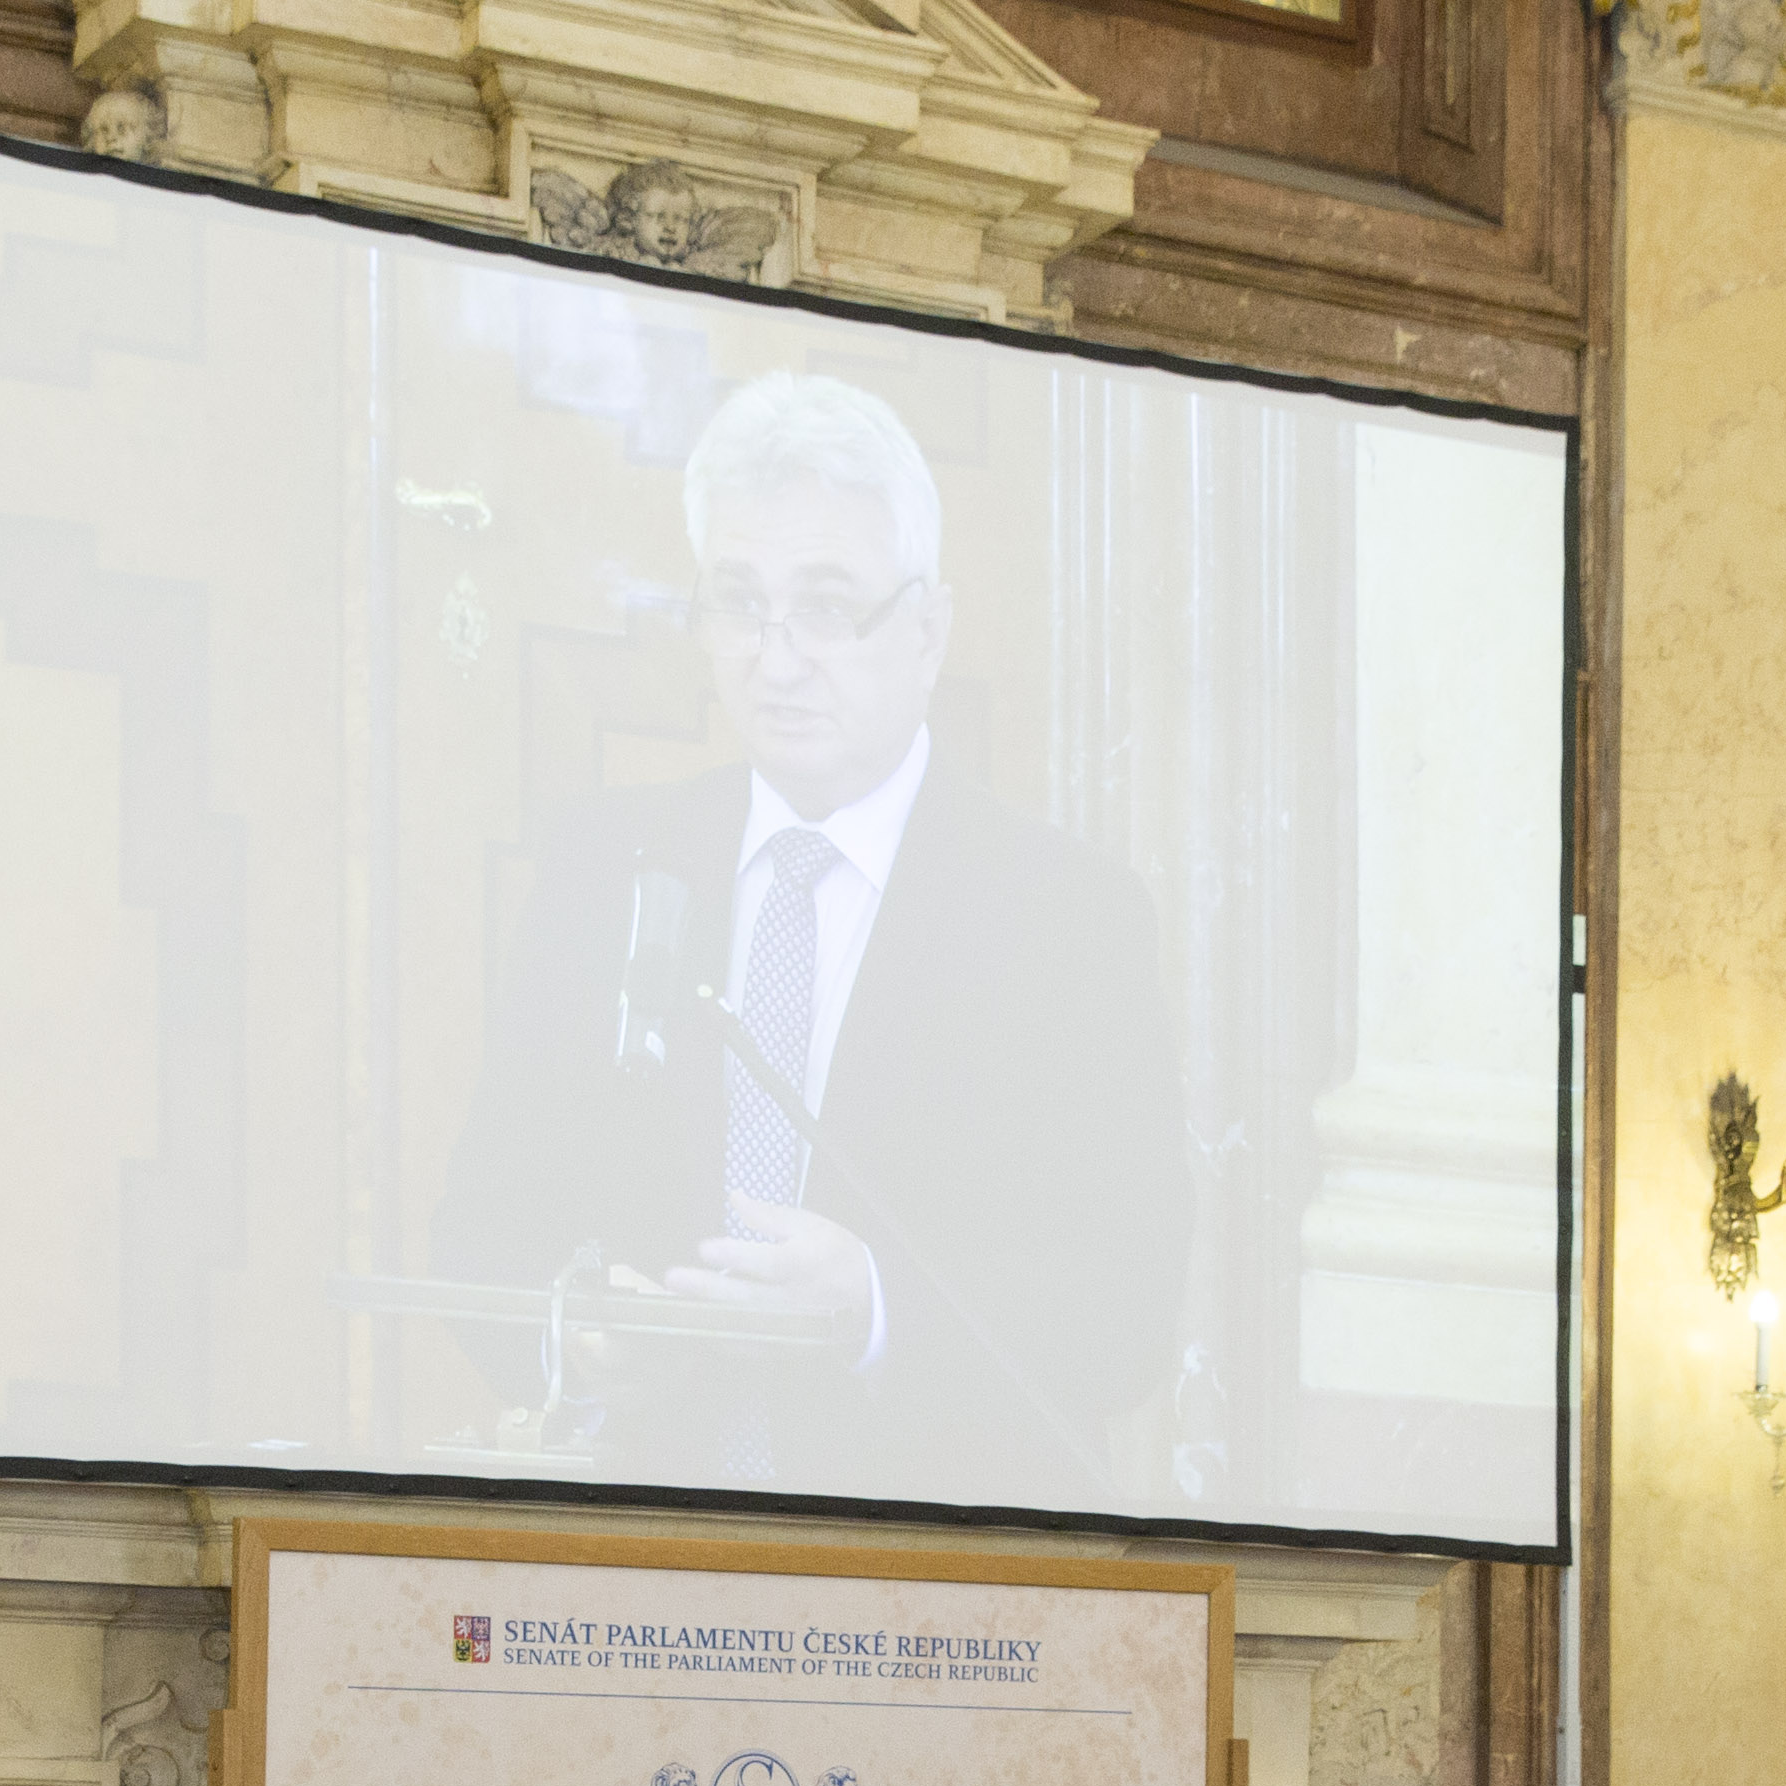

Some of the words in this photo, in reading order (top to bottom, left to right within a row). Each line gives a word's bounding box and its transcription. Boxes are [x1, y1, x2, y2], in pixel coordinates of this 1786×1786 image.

[503, 1617, 597, 1646] SENÁT
[606, 1623, 795, 1653] PARLAMENTU
[803, 1626, 887, 1656] ČESKÉ
[895, 1635, 1043, 1663] REPUBLIKY
[502, 1647, 582, 1667] SENATE
[587, 1650, 615, 1668] OF
[620, 1652, 662, 1669] THE
[667, 1653, 796, 1675] PARLIAMENT
[801, 1657, 828, 1676] OF
[833, 1659, 872, 1677] THE
[877, 1661, 942, 1680] CZECH
[948, 1663, 1039, 1684] REPUBLIC
